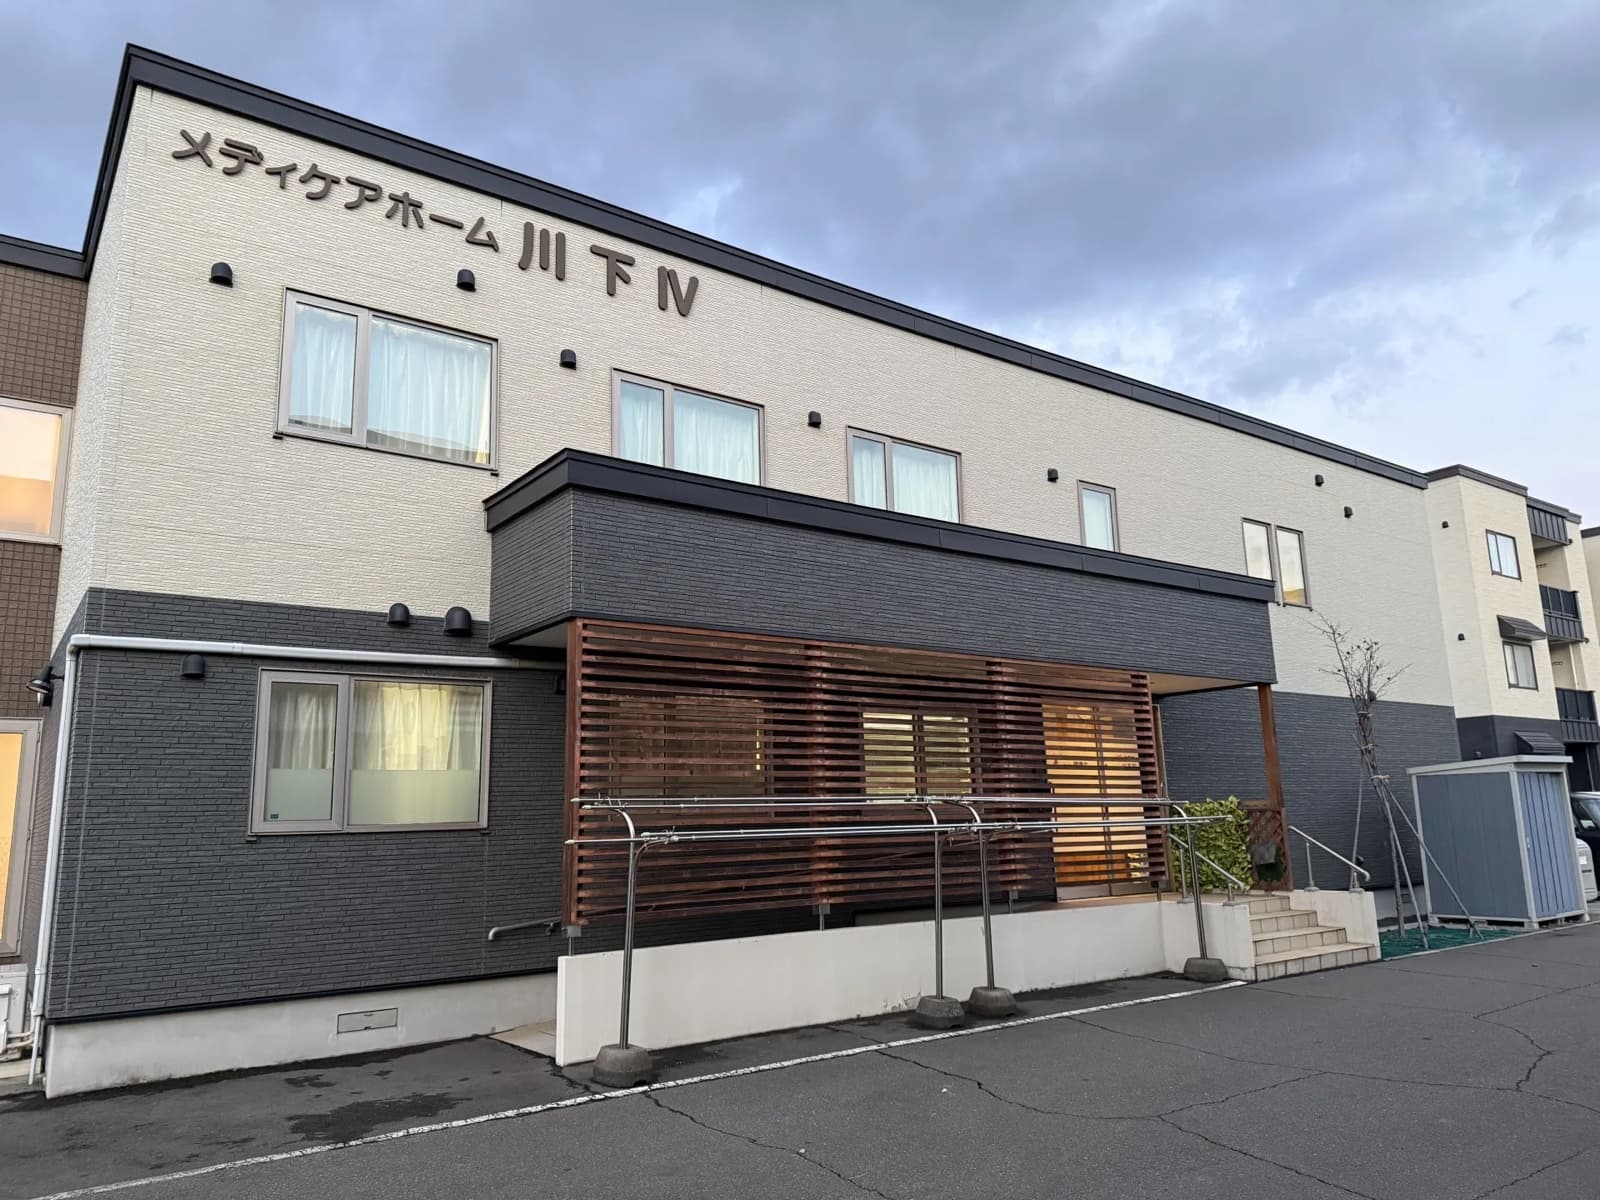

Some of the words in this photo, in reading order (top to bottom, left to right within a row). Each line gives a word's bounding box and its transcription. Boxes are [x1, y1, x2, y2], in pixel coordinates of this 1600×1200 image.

[171, 129, 500, 253] メディケアホーム
